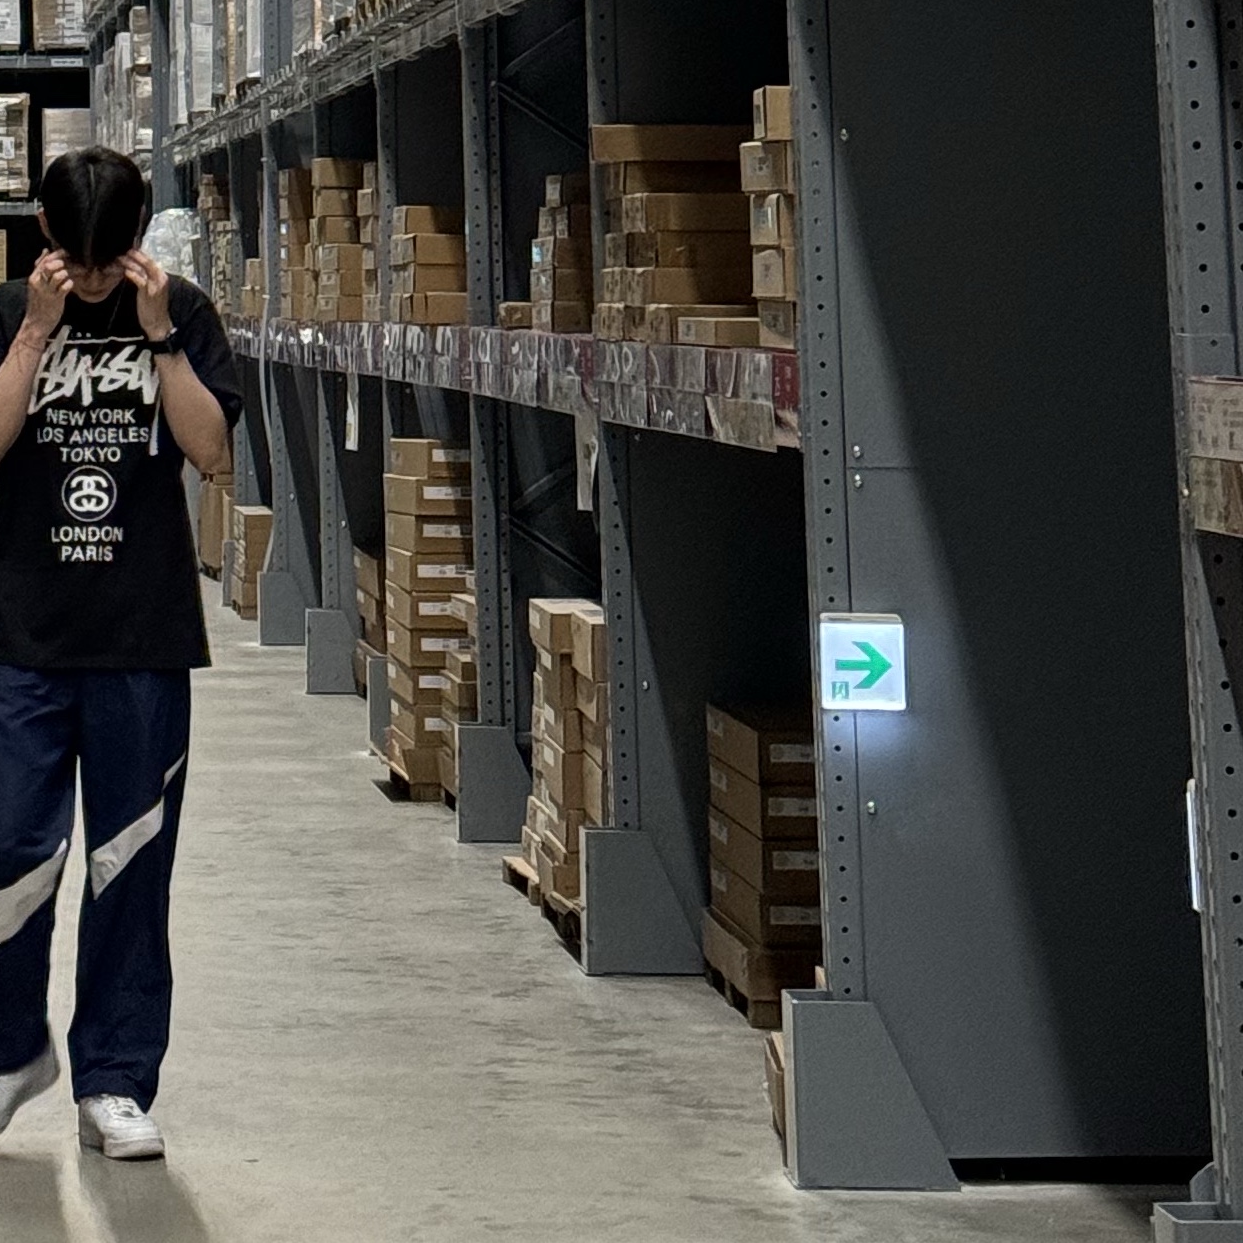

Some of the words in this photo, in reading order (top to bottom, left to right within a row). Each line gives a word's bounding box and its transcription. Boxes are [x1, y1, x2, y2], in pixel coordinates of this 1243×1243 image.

[46, 407, 86, 427] NEW
[89, 408, 136, 425] YORK
[36, 426, 65, 444] LOS
[69, 426, 150, 445] ANGELES
[59, 446, 121, 463] TOKYO
[50, 525, 124, 543] LONDON
[60, 545, 114, 562] PARIS
